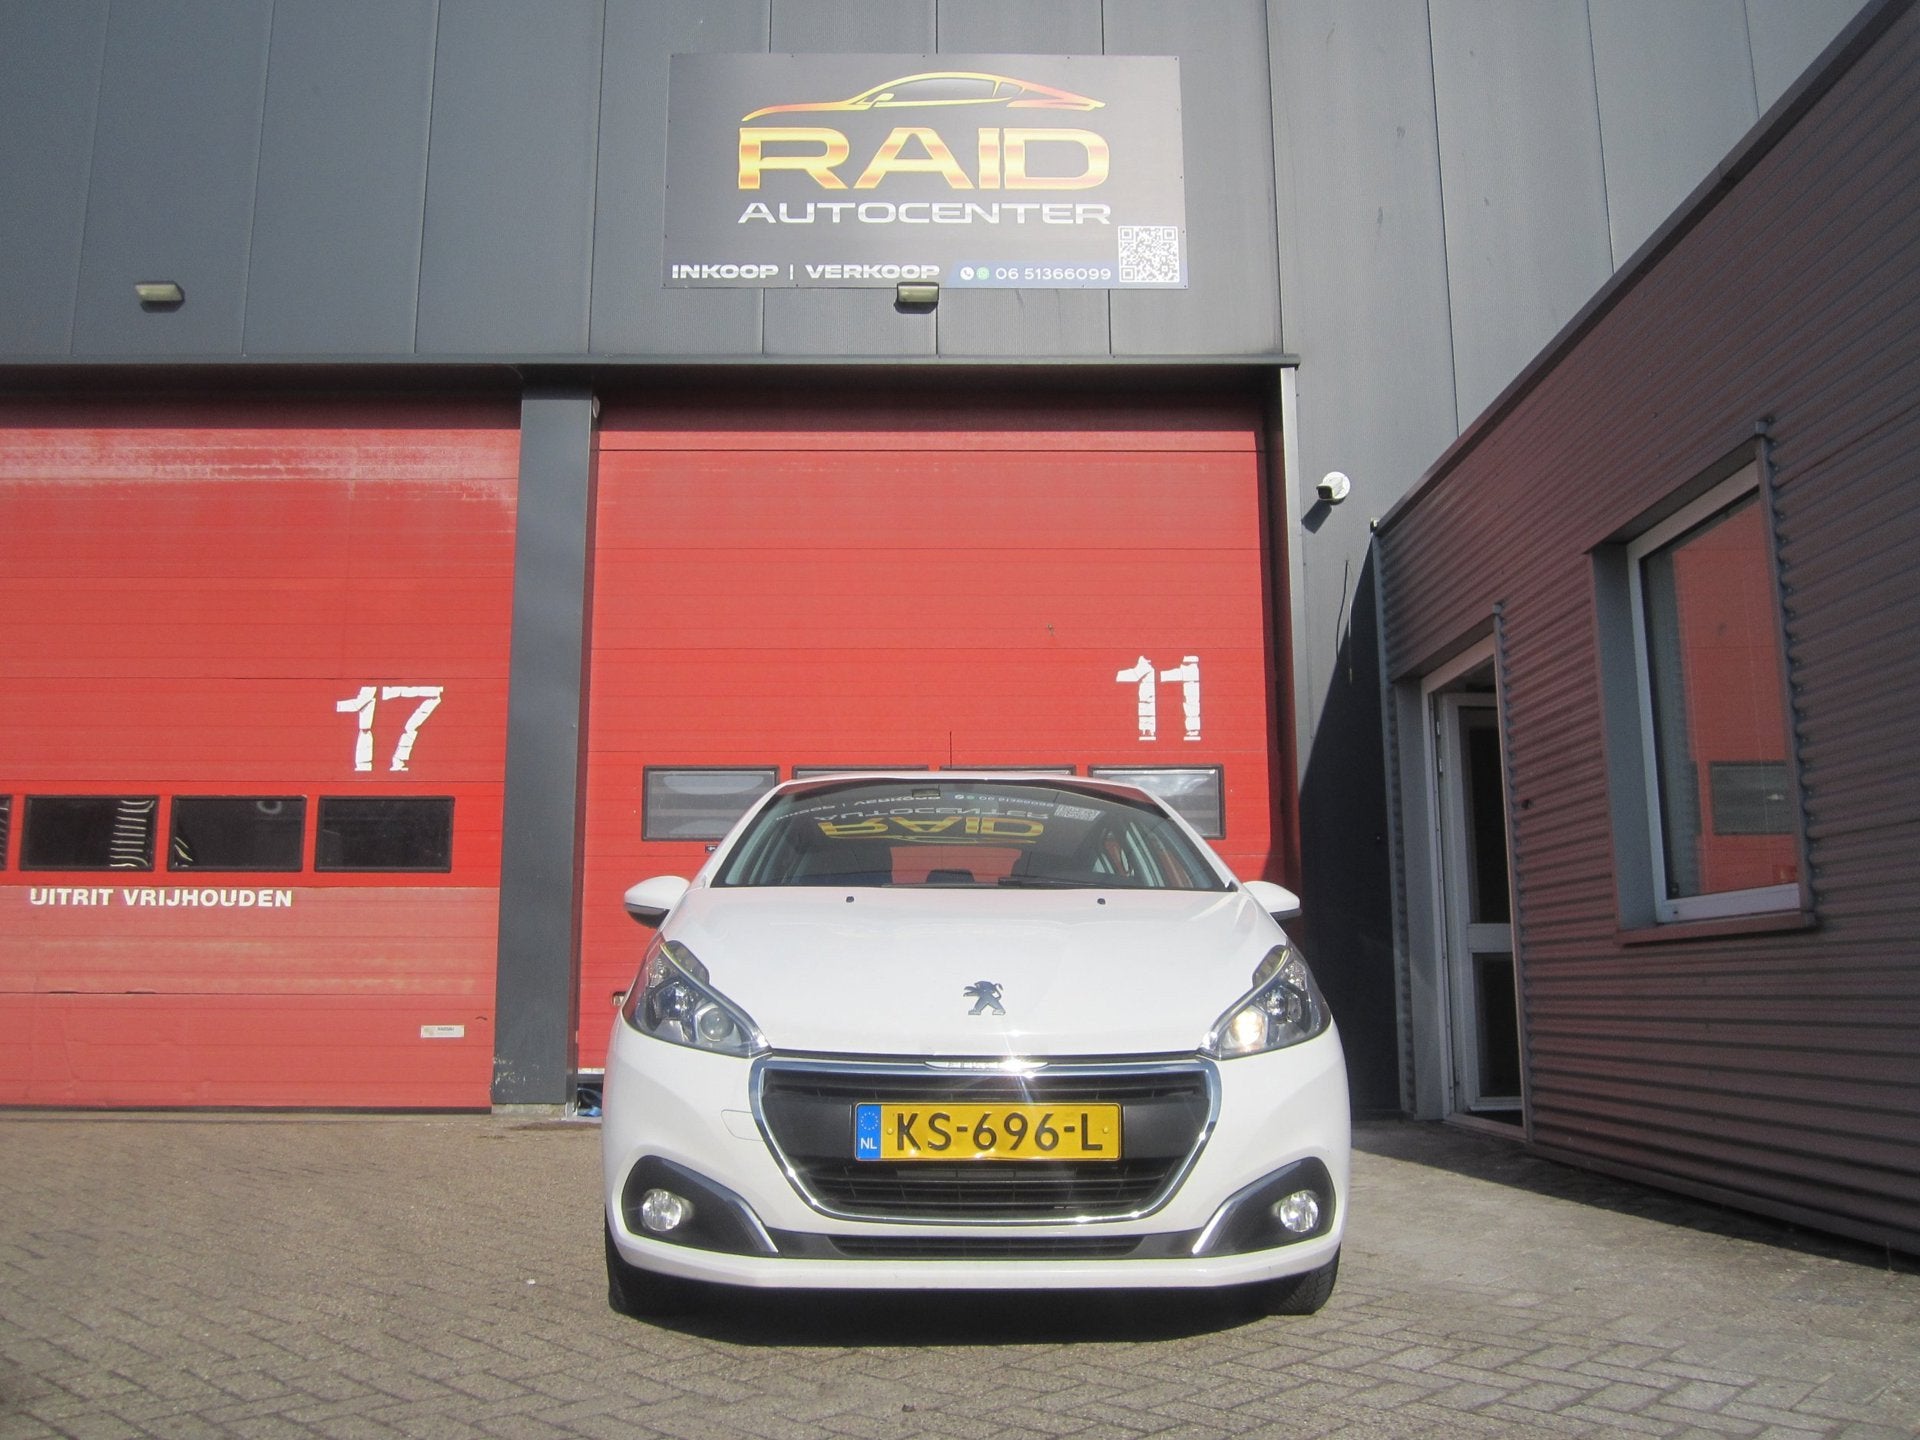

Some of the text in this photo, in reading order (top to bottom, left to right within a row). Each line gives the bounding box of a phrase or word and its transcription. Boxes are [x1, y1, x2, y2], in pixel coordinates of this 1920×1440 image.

[738, 127, 1110, 190] RAID
[738, 202, 1112, 225] AUTOCENTER
[671, 264, 779, 279] INKOOP
[804, 264, 941, 280] VERKOOP
[995, 267, 1112, 280] 06 51366099
[1116, 655, 1201, 741] 11
[336, 686, 444, 771] 17
[30, 888, 293, 908] UITRIT VRIJHOUDEN
[896, 1112, 1103, 1151] KS-696-L
[860, 1137, 878, 1150] NL
